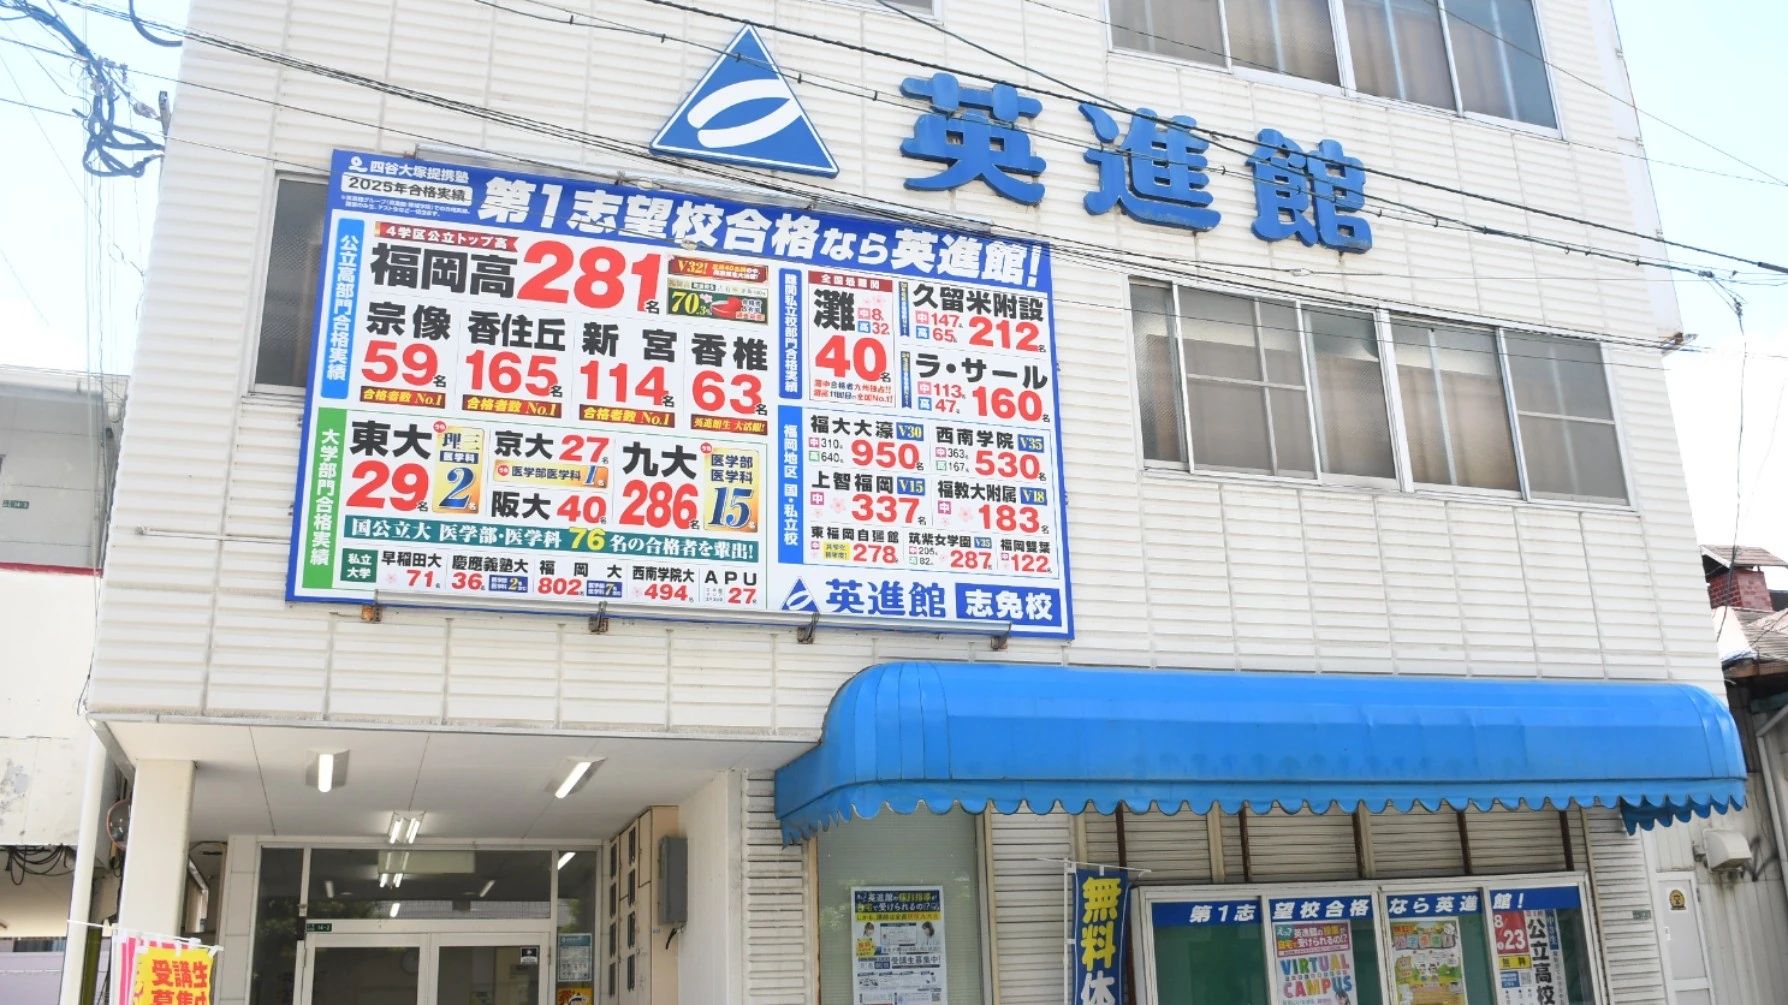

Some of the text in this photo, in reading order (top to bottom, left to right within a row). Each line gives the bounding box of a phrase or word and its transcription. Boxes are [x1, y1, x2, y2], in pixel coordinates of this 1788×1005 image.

[370, 160, 469, 183] 四谷大塚提携塾
[900, 72, 1372, 254] 英進館
[349, 177, 465, 202] 2025年合格実績
[387, 225, 507, 249] 4学区公立トップ高
[370, 243, 517, 298] 福岡高
[326, 235, 360, 381] 公立高部門合格実績
[813, 288, 856, 331] 灘
[913, 283, 1043, 322] 久留米附設
[367, 301, 451, 341] 宗像
[468, 310, 566, 351] 香住丘
[692, 332, 768, 371] 香椎
[916, 353, 1048, 390] ラ・サール
[811, 415, 893, 439] 福大大濠
[898, 424, 922, 438] V30
[936, 426, 1014, 449] 西南学院
[350, 420, 432, 460] 東大
[494, 430, 554, 460] 京大
[783, 424, 799, 480] 福岡地区
[1020, 436, 1043, 450] V35
[623, 442, 697, 480] 九大
[711, 454, 754, 468] 医学部
[710, 469, 754, 485] 医学科
[811, 470, 893, 494] 上智福岡
[898, 479, 923, 494] V15
[310, 428, 340, 566] 大学部門合格実績
[938, 481, 1017, 503] 福教大附属
[1021, 489, 1045, 503] V18
[491, 490, 551, 520] 阪大
[351, 518, 432, 541] 国公立大
[569, 527, 606, 551] 76
[909, 532, 971, 548] 筑紫女学園
[348, 553, 371, 565] 私立
[381, 551, 442, 568] 早稲田大
[452, 555, 528, 573] 慶應義塾大
[540, 560, 622, 578] 福岡大
[347, 567, 371, 579] 大学
[633, 565, 695, 583] 西南学院大
[826, 579, 946, 618] 英進館
[965, 590, 1053, 621] 志免校
[1504, 929, 1525, 949] 23
[1280, 953, 1350, 975] VIRTUAL
[1528, 918, 1555, 1004] 公立高校
[152, 959, 208, 988] 受講生
[1284, 975, 1352, 998] CAMPUS
